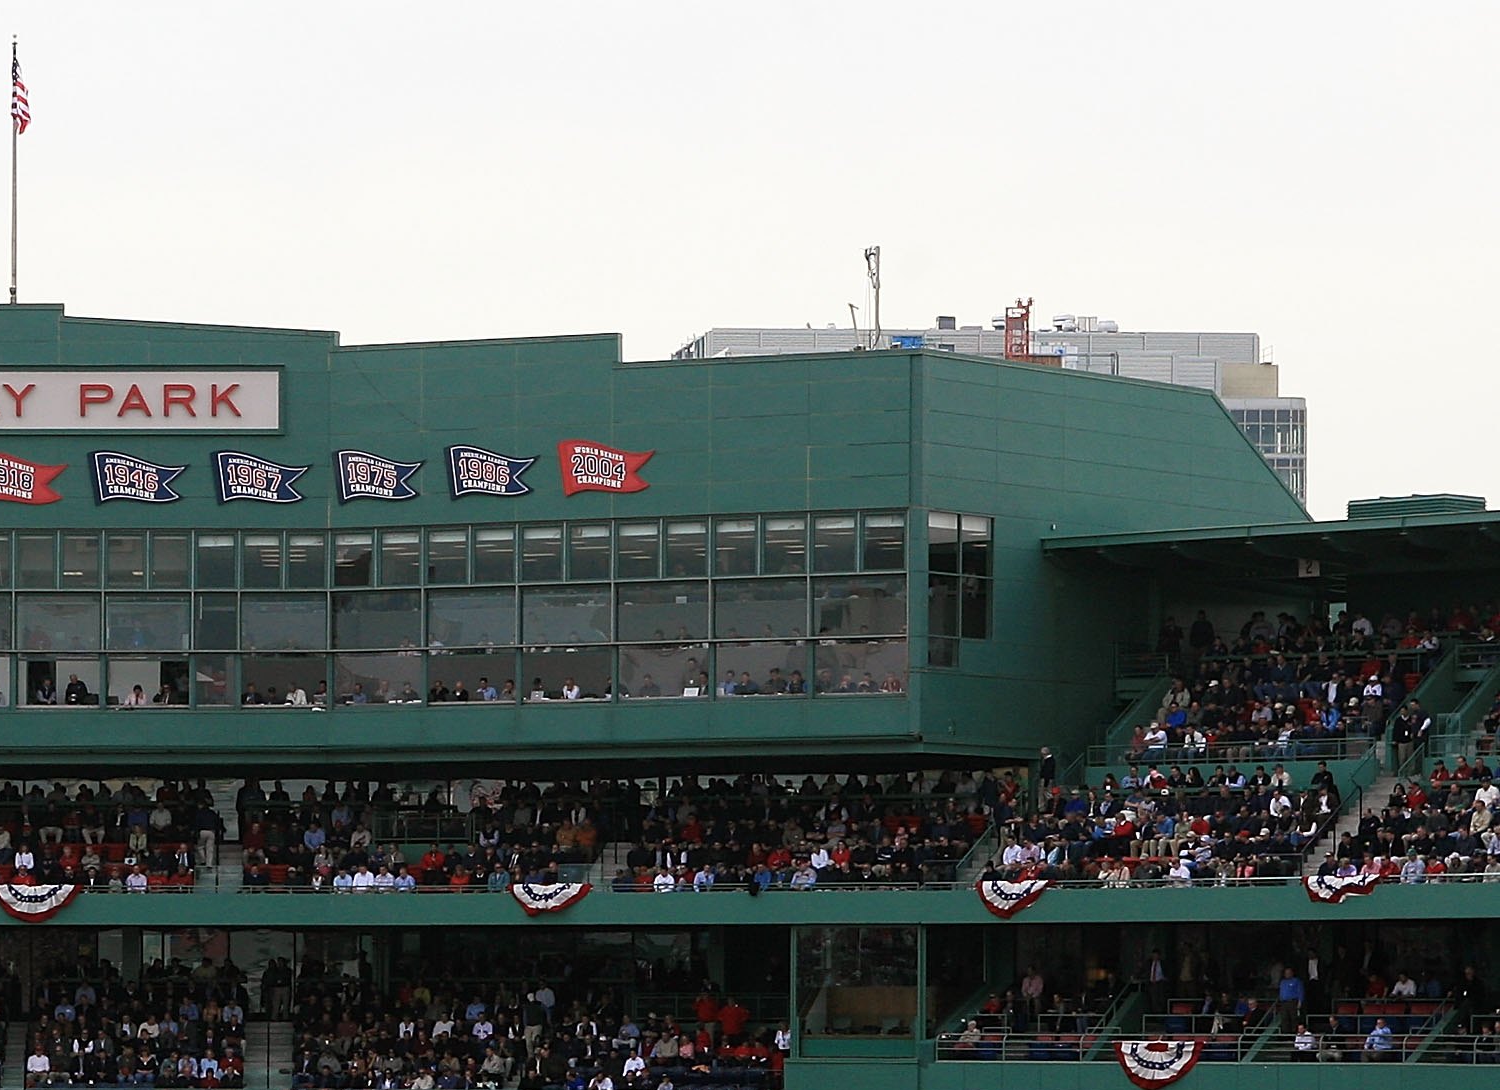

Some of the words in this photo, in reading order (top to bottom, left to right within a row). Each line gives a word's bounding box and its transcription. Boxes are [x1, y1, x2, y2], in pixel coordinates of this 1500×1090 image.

[79, 383, 242, 417] PARK
[460, 451, 487, 460] AMERICAN
[487, 456, 508, 466] LEAGUE
[573, 446, 599, 455] WORLD
[599, 450, 624, 461] SERIES
[9, 461, 34, 473] SERIES
[105, 458, 134, 467] AMERICAN
[135, 463, 156, 473] LEAGUE
[228, 458, 257, 467] AMERICAN
[258, 463, 280, 473] LEAGUE
[348, 456, 374, 465] AMERICAN
[375, 461, 395, 470] LEAGUE
[571, 454, 625, 481] 2004
[104, 464, 158, 491] 1946
[227, 464, 281, 491] 1967
[347, 462, 397, 489] 1975
[459, 458, 510, 485] 1986
[463, 479, 506, 493] CHAMPIONS
[577, 475, 622, 488] CHAMPIONS
[108, 485, 155, 499] CHAMPIONS
[231, 485, 278, 499] CHAMPIONS
[351, 483, 393, 497] CHAMPIONS
